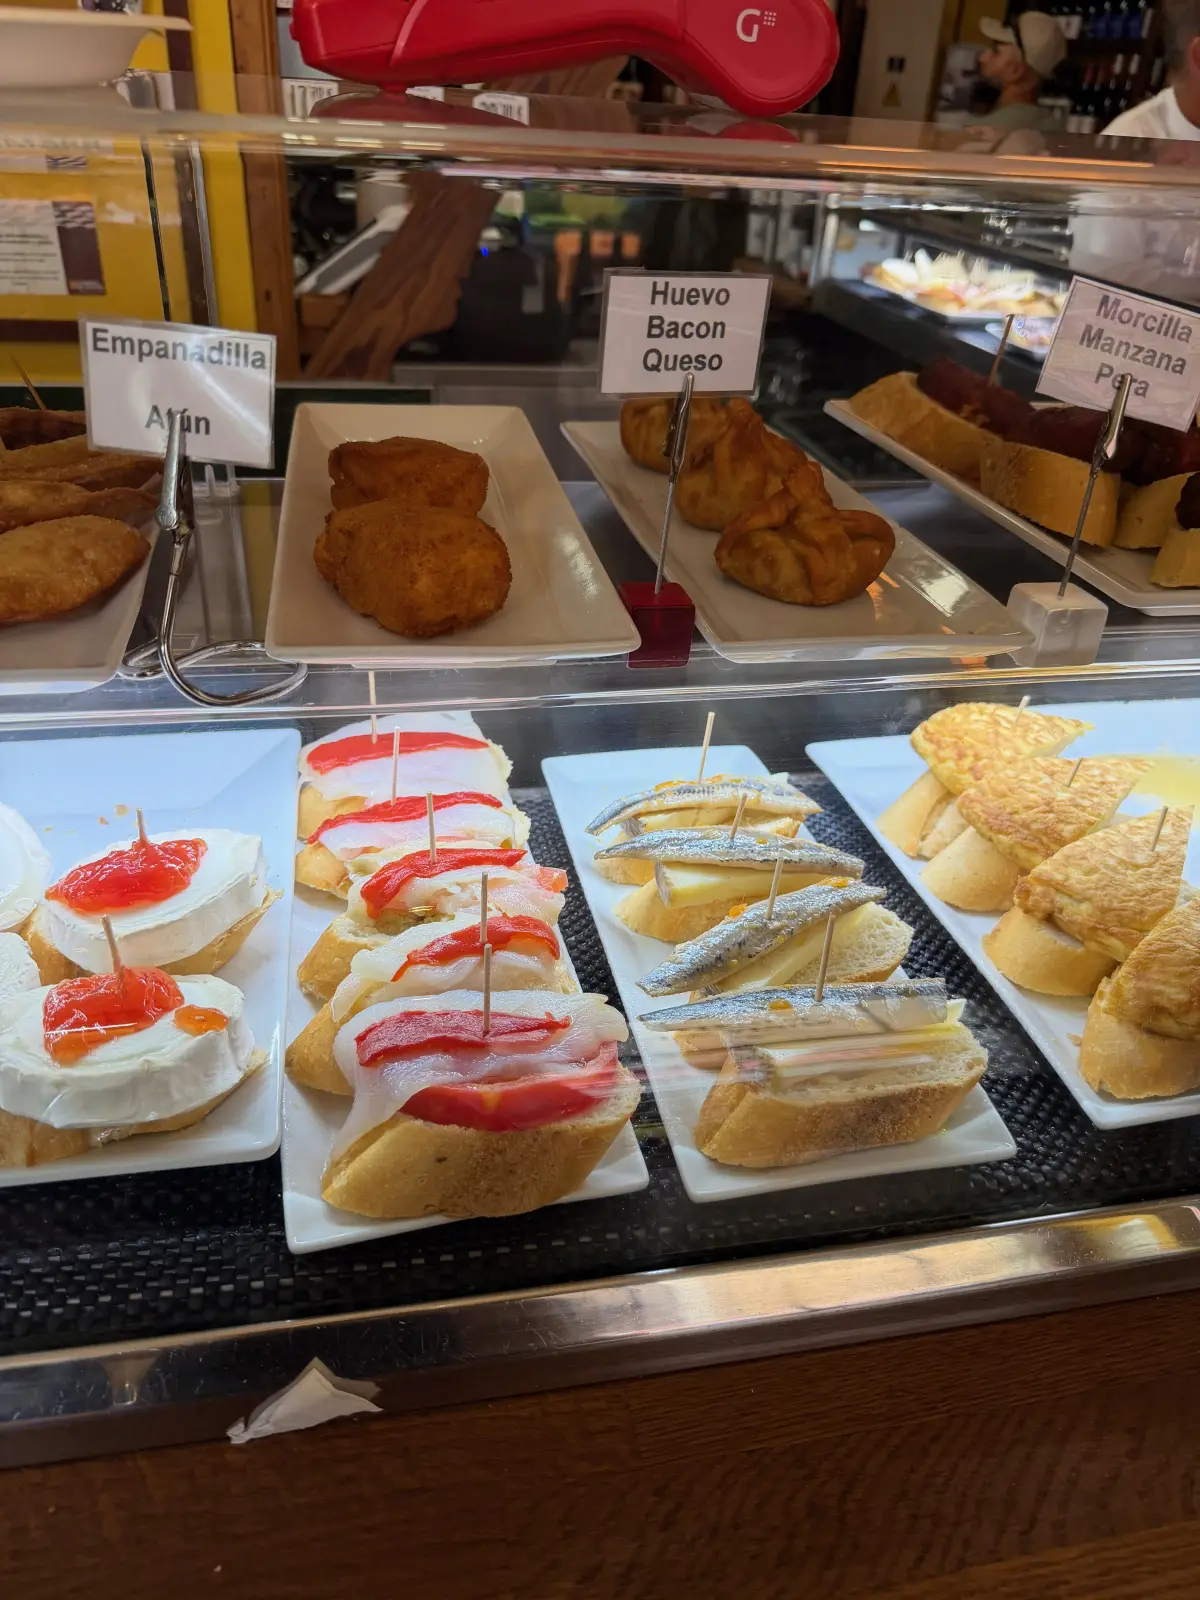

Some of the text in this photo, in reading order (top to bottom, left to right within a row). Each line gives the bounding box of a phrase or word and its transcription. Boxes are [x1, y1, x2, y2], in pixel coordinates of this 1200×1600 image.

[650, 281, 731, 306] Huevo
[646, 315, 726, 339] Bacon
[1096, 294, 1193, 343] Morcilla
[92, 327, 267, 369] Empanadilla
[642, 348, 724, 373] Queso
[1078, 324, 1187, 375] Manzana
